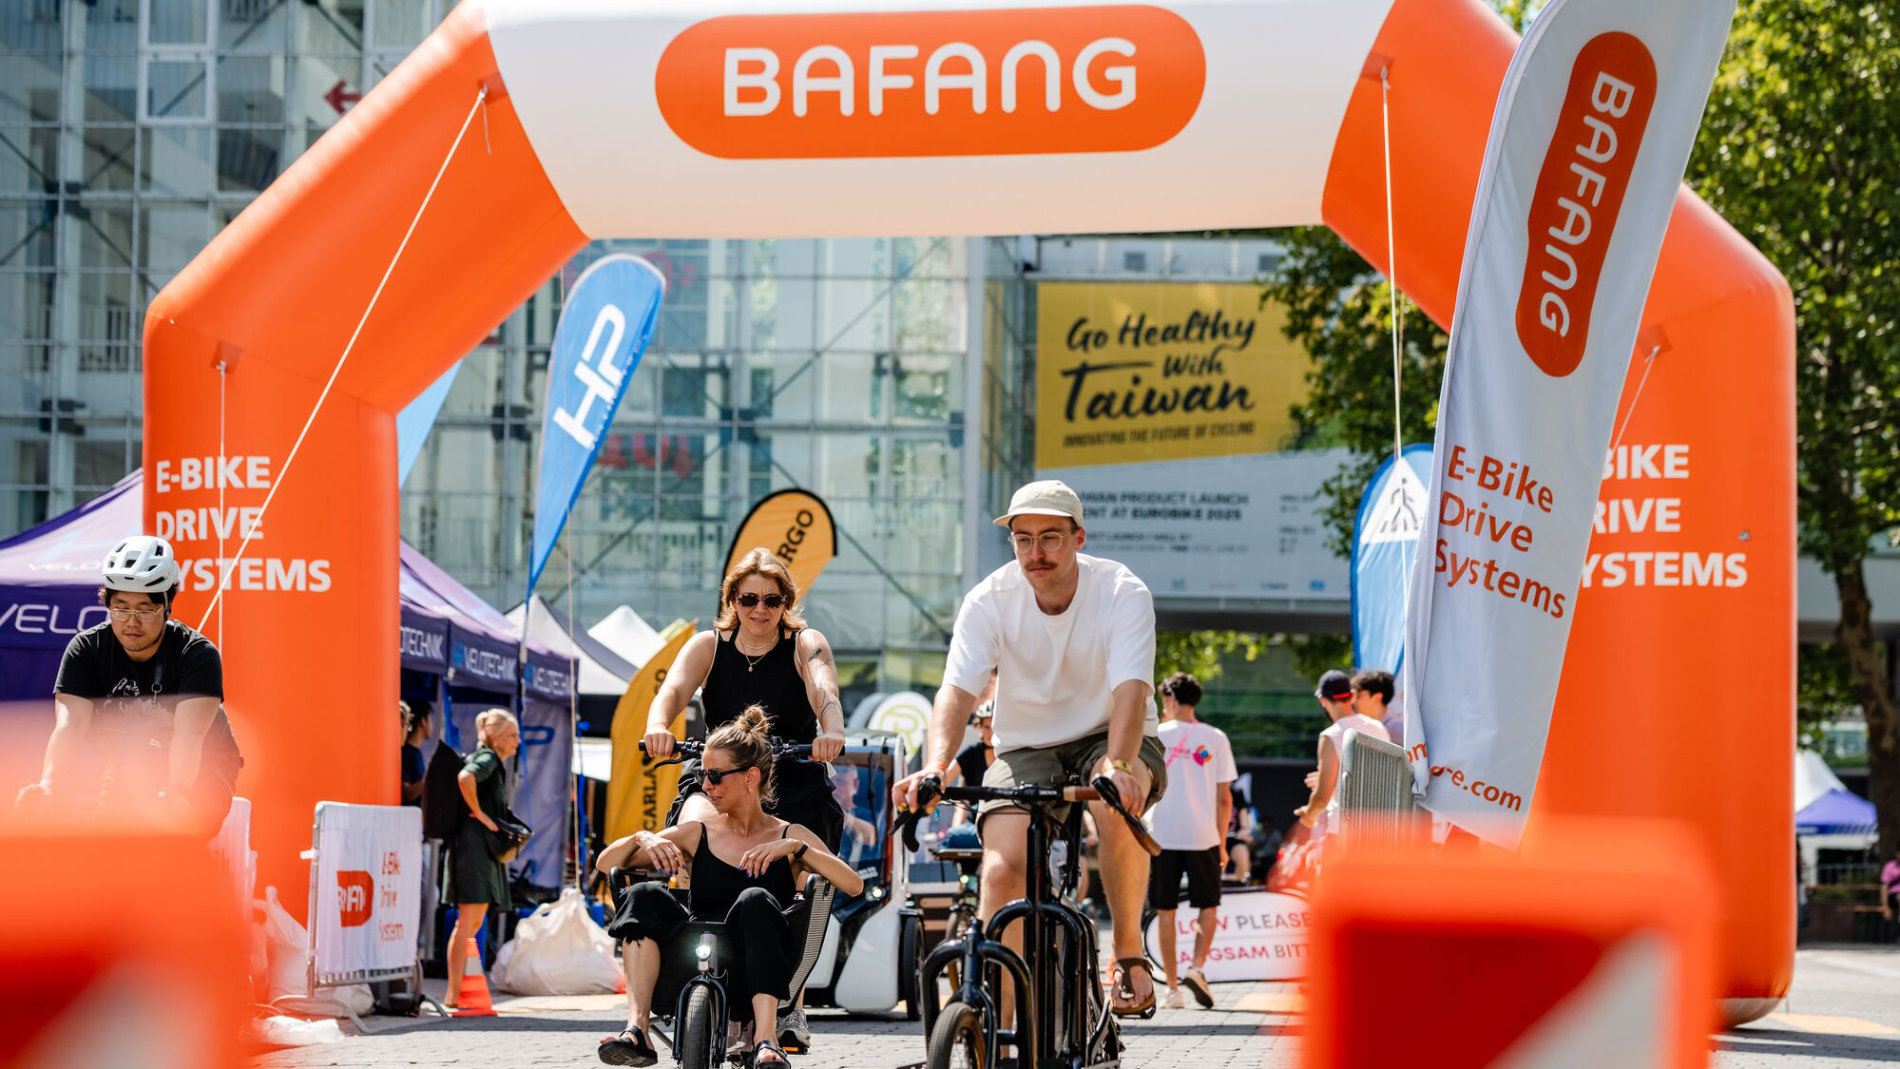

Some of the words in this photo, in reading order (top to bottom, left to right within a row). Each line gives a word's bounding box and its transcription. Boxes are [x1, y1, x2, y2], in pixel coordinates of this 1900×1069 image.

[723, 37, 1138, 118] BAFANG
[1540, 71, 1635, 338] BAFANG
[1067, 317, 1108, 351] Go
[1118, 310, 1255, 350] Healthy
[552, 303, 626, 450] HP
[1163, 346, 1225, 378] With
[1061, 362, 1255, 422] Taiwan
[1064, 429, 1126, 448] INNOVATING
[1130, 427, 1148, 443] THE
[1151, 425, 1191, 442] FUTURE
[1195, 423, 1207, 437] OF
[1210, 421, 1255, 437] CYCLING
[156, 456, 271, 493] E-BIKE
[1448, 445, 1554, 513] E-Bike
[1602, 444, 1689, 480] BIKE
[1083, 508, 1106, 518] ENT
[1111, 508, 1127, 518] AT
[1131, 508, 1203, 519] EUROBIKE
[1207, 509, 1241, 519] 2025
[1121, 491, 1187, 503] PRODUCT
[1192, 492, 1249, 504] LAUNCH
[156, 507, 264, 541] DRIVE
[1439, 491, 1533, 552] Drive
[1593, 498, 1681, 534] RIVE
[776, 510, 814, 563] RGO
[176, 558, 331, 592] YSTEMS
[1435, 538, 1566, 619] Systems
[1581, 552, 1748, 588] YSTEMS
[1236, 912, 1312, 930] PLEASE
[1274, 943, 1312, 959] BITT
